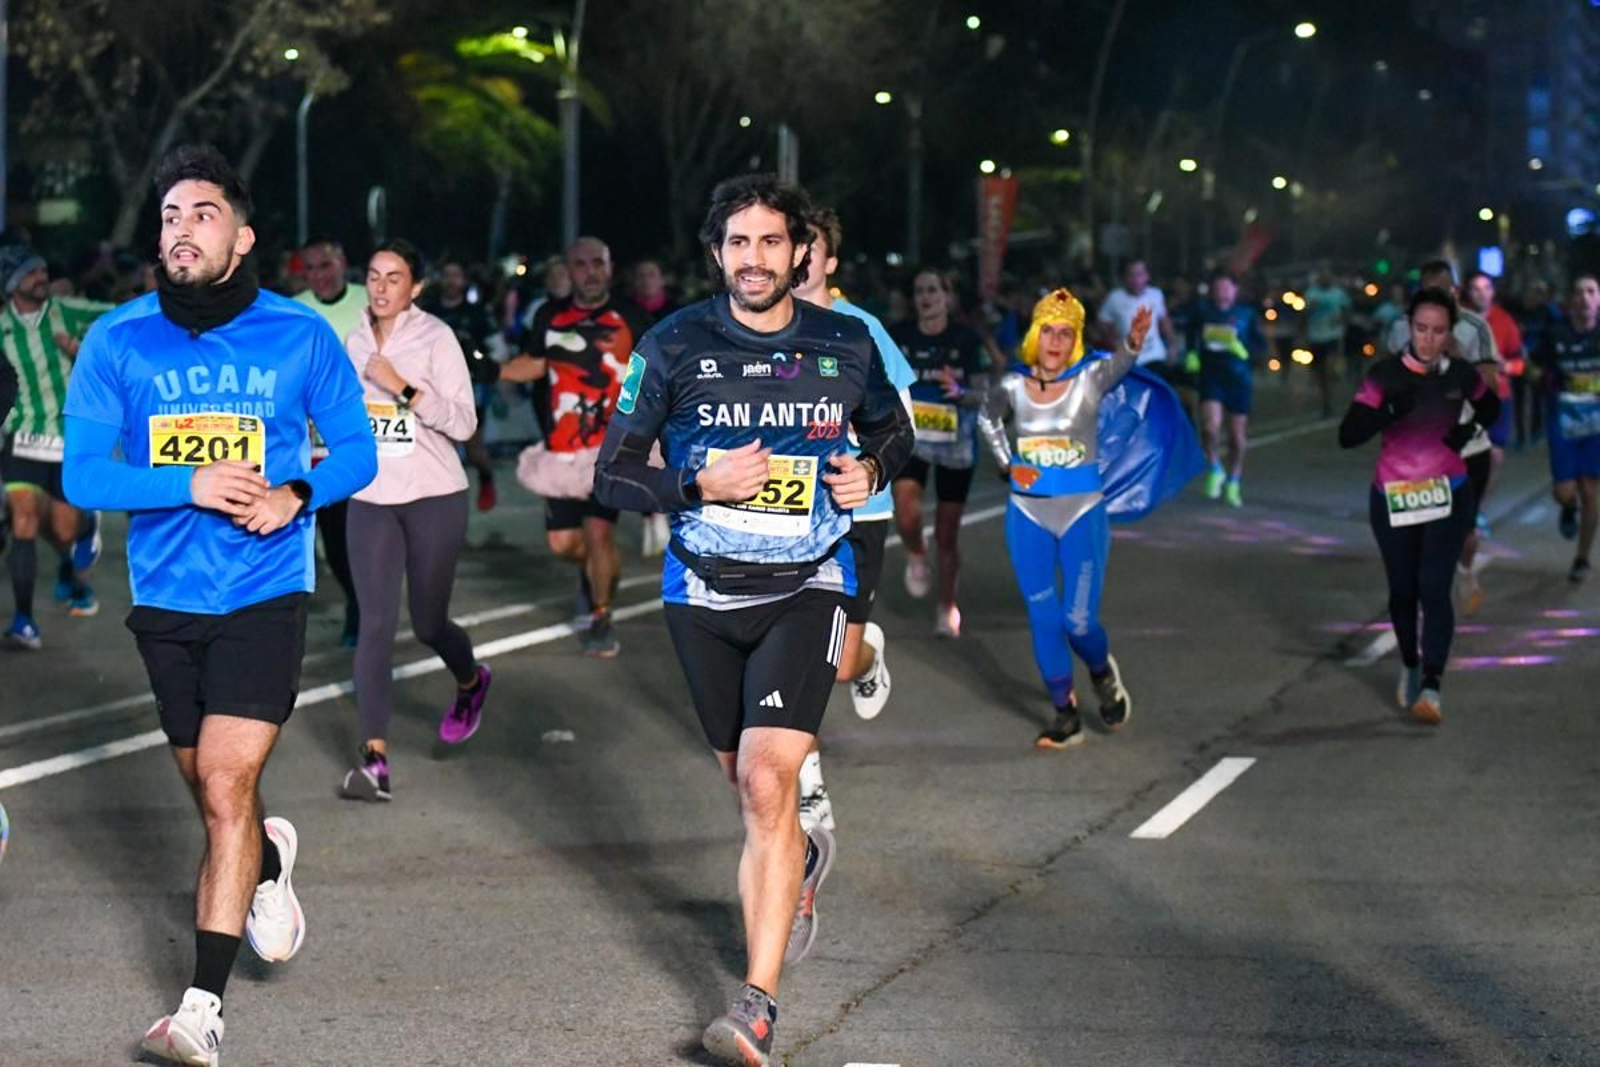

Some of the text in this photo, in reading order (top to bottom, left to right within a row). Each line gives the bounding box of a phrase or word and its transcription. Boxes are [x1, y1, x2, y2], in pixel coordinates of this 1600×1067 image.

[743, 361, 772, 377] jaén
[154, 364, 277, 401] UCAM
[158, 401, 275, 418] UNIVERSIDAD
[697, 397, 843, 427] SAN ANTÓN
[368, 417, 408, 435] 974
[806, 421, 841, 440] 2025
[159, 436, 249, 462] 4201
[742, 479, 805, 506] 52
[1392, 486, 1447, 509] 1008
